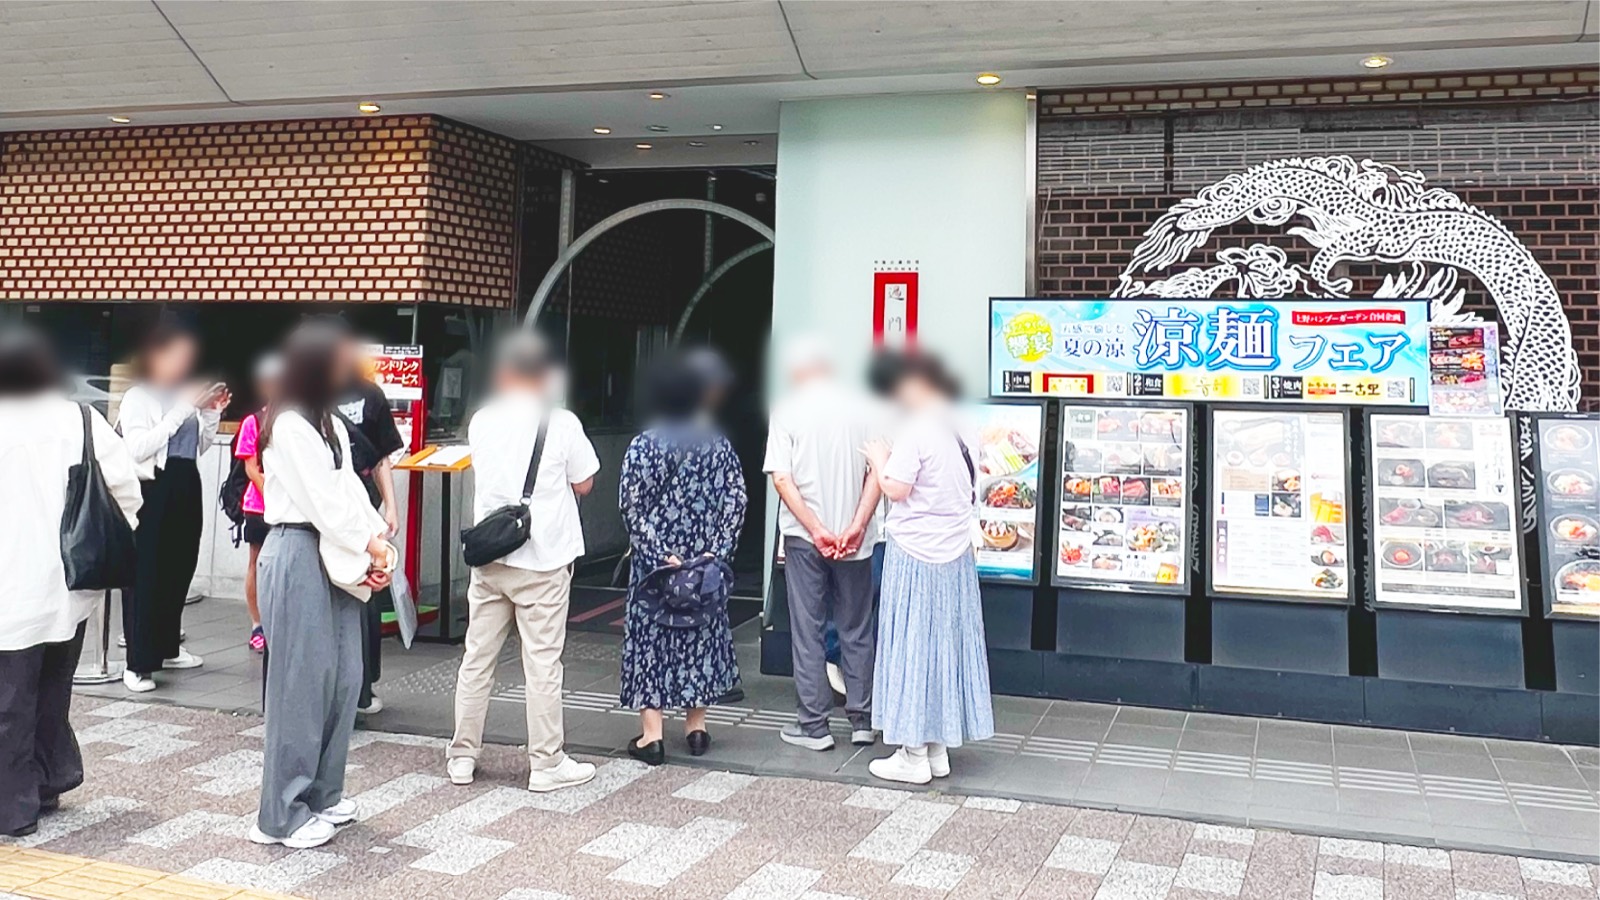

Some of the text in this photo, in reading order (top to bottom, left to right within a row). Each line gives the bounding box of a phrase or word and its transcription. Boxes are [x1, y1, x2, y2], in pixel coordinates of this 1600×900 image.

[1063, 337, 1126, 358] 夏の涼
[385, 373, 419, 385] サービス
